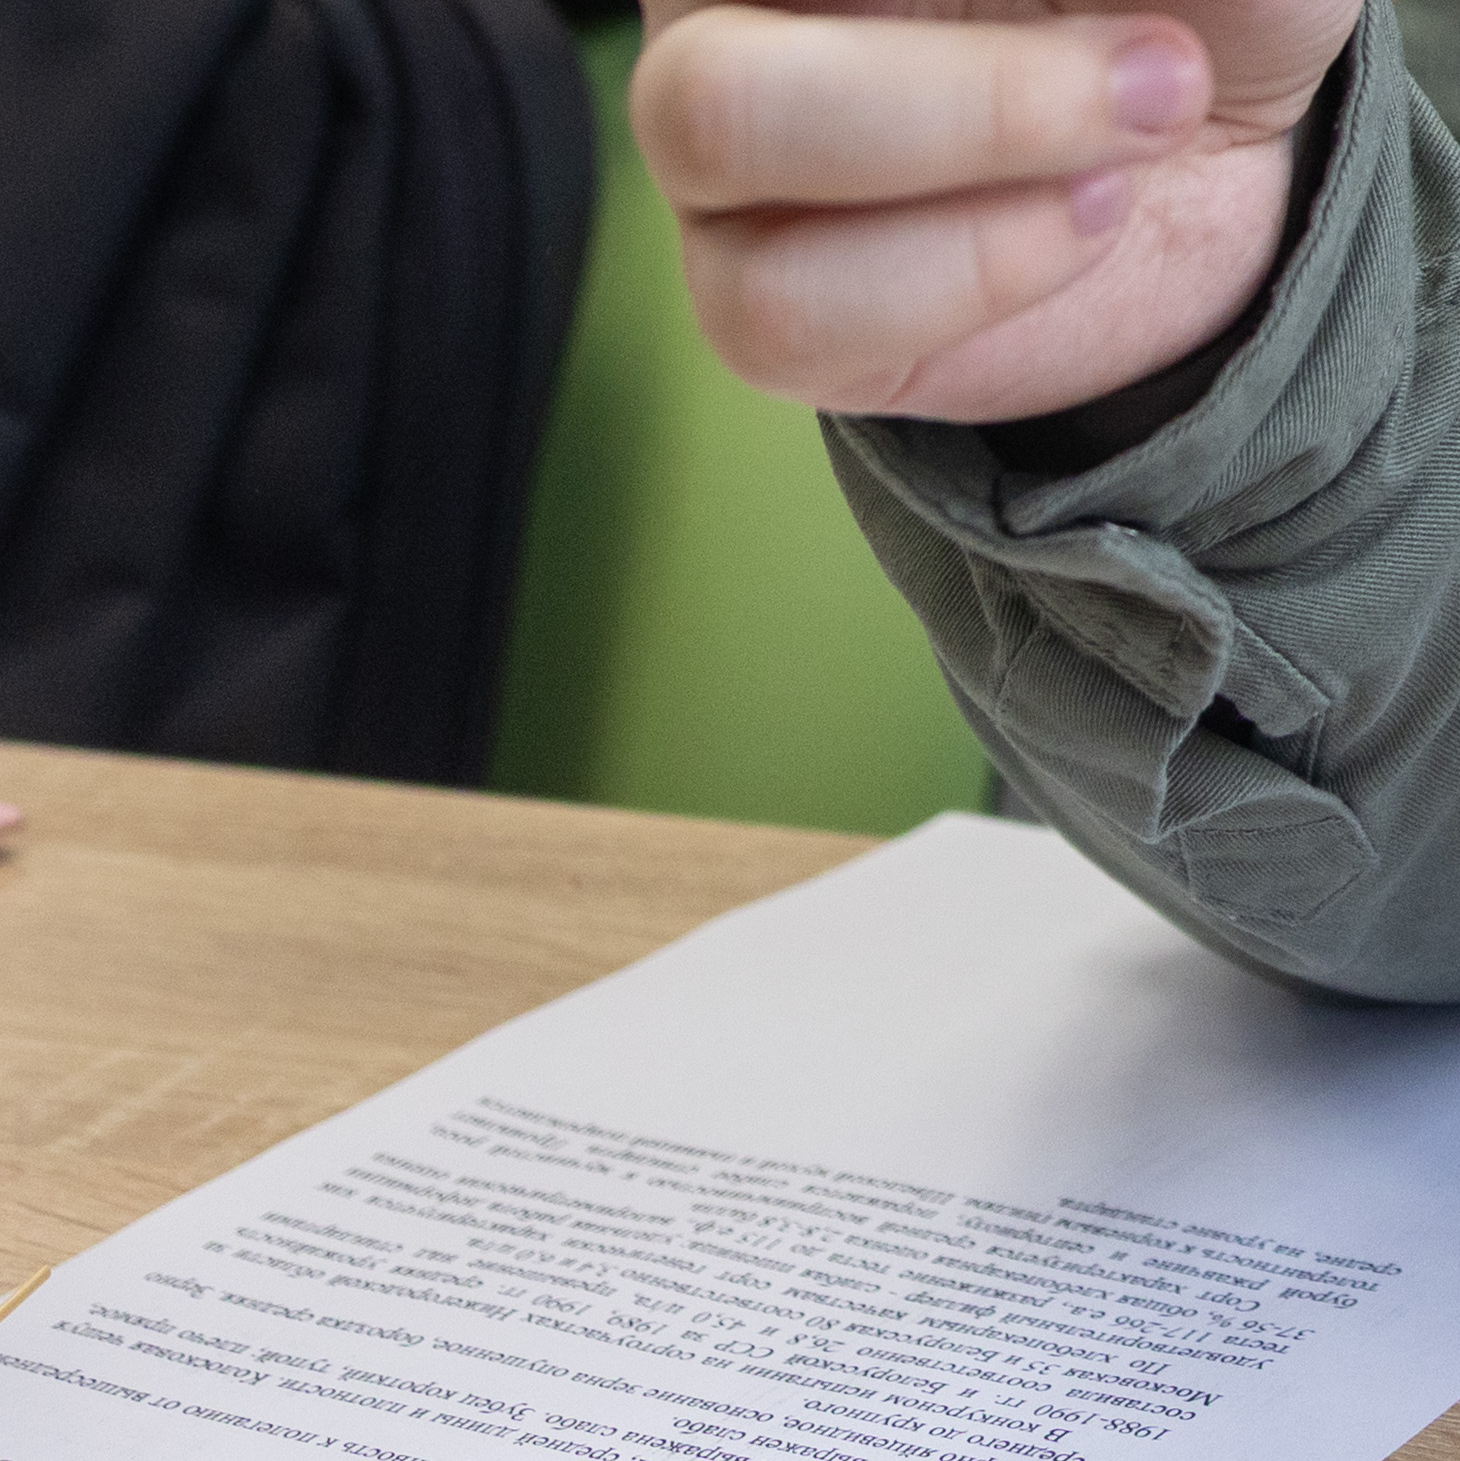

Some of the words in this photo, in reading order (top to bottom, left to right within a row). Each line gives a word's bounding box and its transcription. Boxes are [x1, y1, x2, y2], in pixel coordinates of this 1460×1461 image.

[930, 1254, 1114, 1301] хлебопекарная
[984, 1244, 1188, 1295] характеризуется
[1140, 1257, 1271, 1291] ржавчине
[1200, 1247, 1380, 1292] толерантность
[618, 1269, 806, 1320] соответственно
[897, 1269, 1055, 1308] разжижение
[1195, 1290, 1262, 1312] Сорт
[1277, 1286, 1359, 1310] бурой
[781, 1286, 909, 1321] качествам
[902, 1290, 997, 1320] филлер
[1114, 1293, 1199, 1318] общая
[524, 1311, 697, 1361] сортоучастках
[605, 1309, 669, 1335] 1989,
[679, 1328, 708, 1342] за
[757, 1325, 780, 1337] и
[803, 1315, 841, 1331] 80
[1111, 1315, 1213, 1343] 117-266
[1240, 1319, 1316, 1341] 37-56
[712, 1339, 775, 1359] ССР
[785, 1333, 846, 1353] 26,8
[842, 1321, 1001, 1363] Белорусская
[916, 1315, 1119, 1364] хлебопекарным
[999, 1311, 1275, 1370] удовлетворительный
[1221, 1334, 1290, 1355] теста
[127, 1340, 271, 1386] Колосковая
[250, 1346, 332, 1374] тупой;
[699, 1355, 735, 1369] на
[783, 1352, 949, 1395] Белорусской
[854, 1346, 1053, 1392] соответственно
[1002, 1353, 1024, 1366] и
[1020, 1360, 1061, 1376] 35
[1127, 1359, 1171, 1376] По
[276, 1376, 408, 1414] плотности.
[338, 1365, 459, 1401] короткий,
[569, 1371, 643, 1394] зерна
[736, 1363, 879, 1399] испытании
[956, 1387, 980, 1399] и
[1061, 1366, 1224, 1407] Московская
[146, 1396, 182, 1410] от
[406, 1406, 431, 1419] и
[457, 1392, 536, 1422] Зубец
[640, 1387, 775, 1422] основание
[802, 1397, 926, 1432] крупного.
[880, 1393, 1042, 1433] конкурсном
[993, 1393, 1027, 1408] гг.
[1064, 1387, 1197, 1421] составила
[180, 1404, 320, 1444] полеганию
[428, 1411, 519, 1438] длины
[543, 1411, 619, 1437] слабо.
[671, 1415, 747, 1441] слабо.
[781, 1414, 939, 1458] яйцевидное,
[927, 1425, 966, 1440] до
[1032, 1403, 1171, 1441] 1988-1990
[1042, 1427, 1072, 1443] В
[315, 1436, 339, 1448] к
